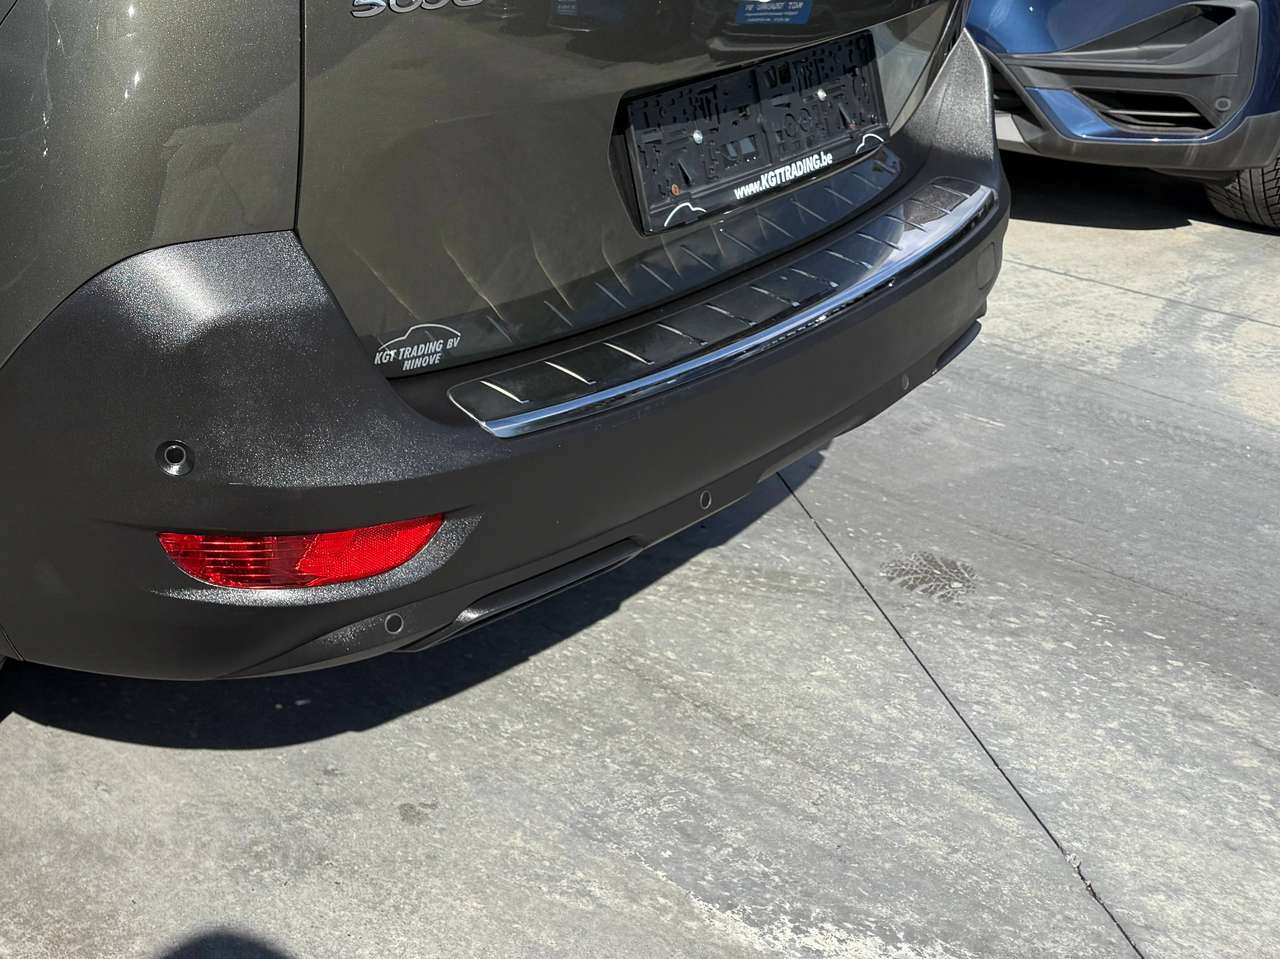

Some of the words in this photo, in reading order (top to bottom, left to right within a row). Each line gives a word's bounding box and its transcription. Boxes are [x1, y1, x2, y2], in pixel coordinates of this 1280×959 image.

[733, 151, 833, 200] www.KGTTRADING.be
[373, 349, 398, 366] KGT
[398, 339, 444, 360] TRADING
[446, 336, 461, 350] BV
[402, 352, 442, 372] NINOVE
